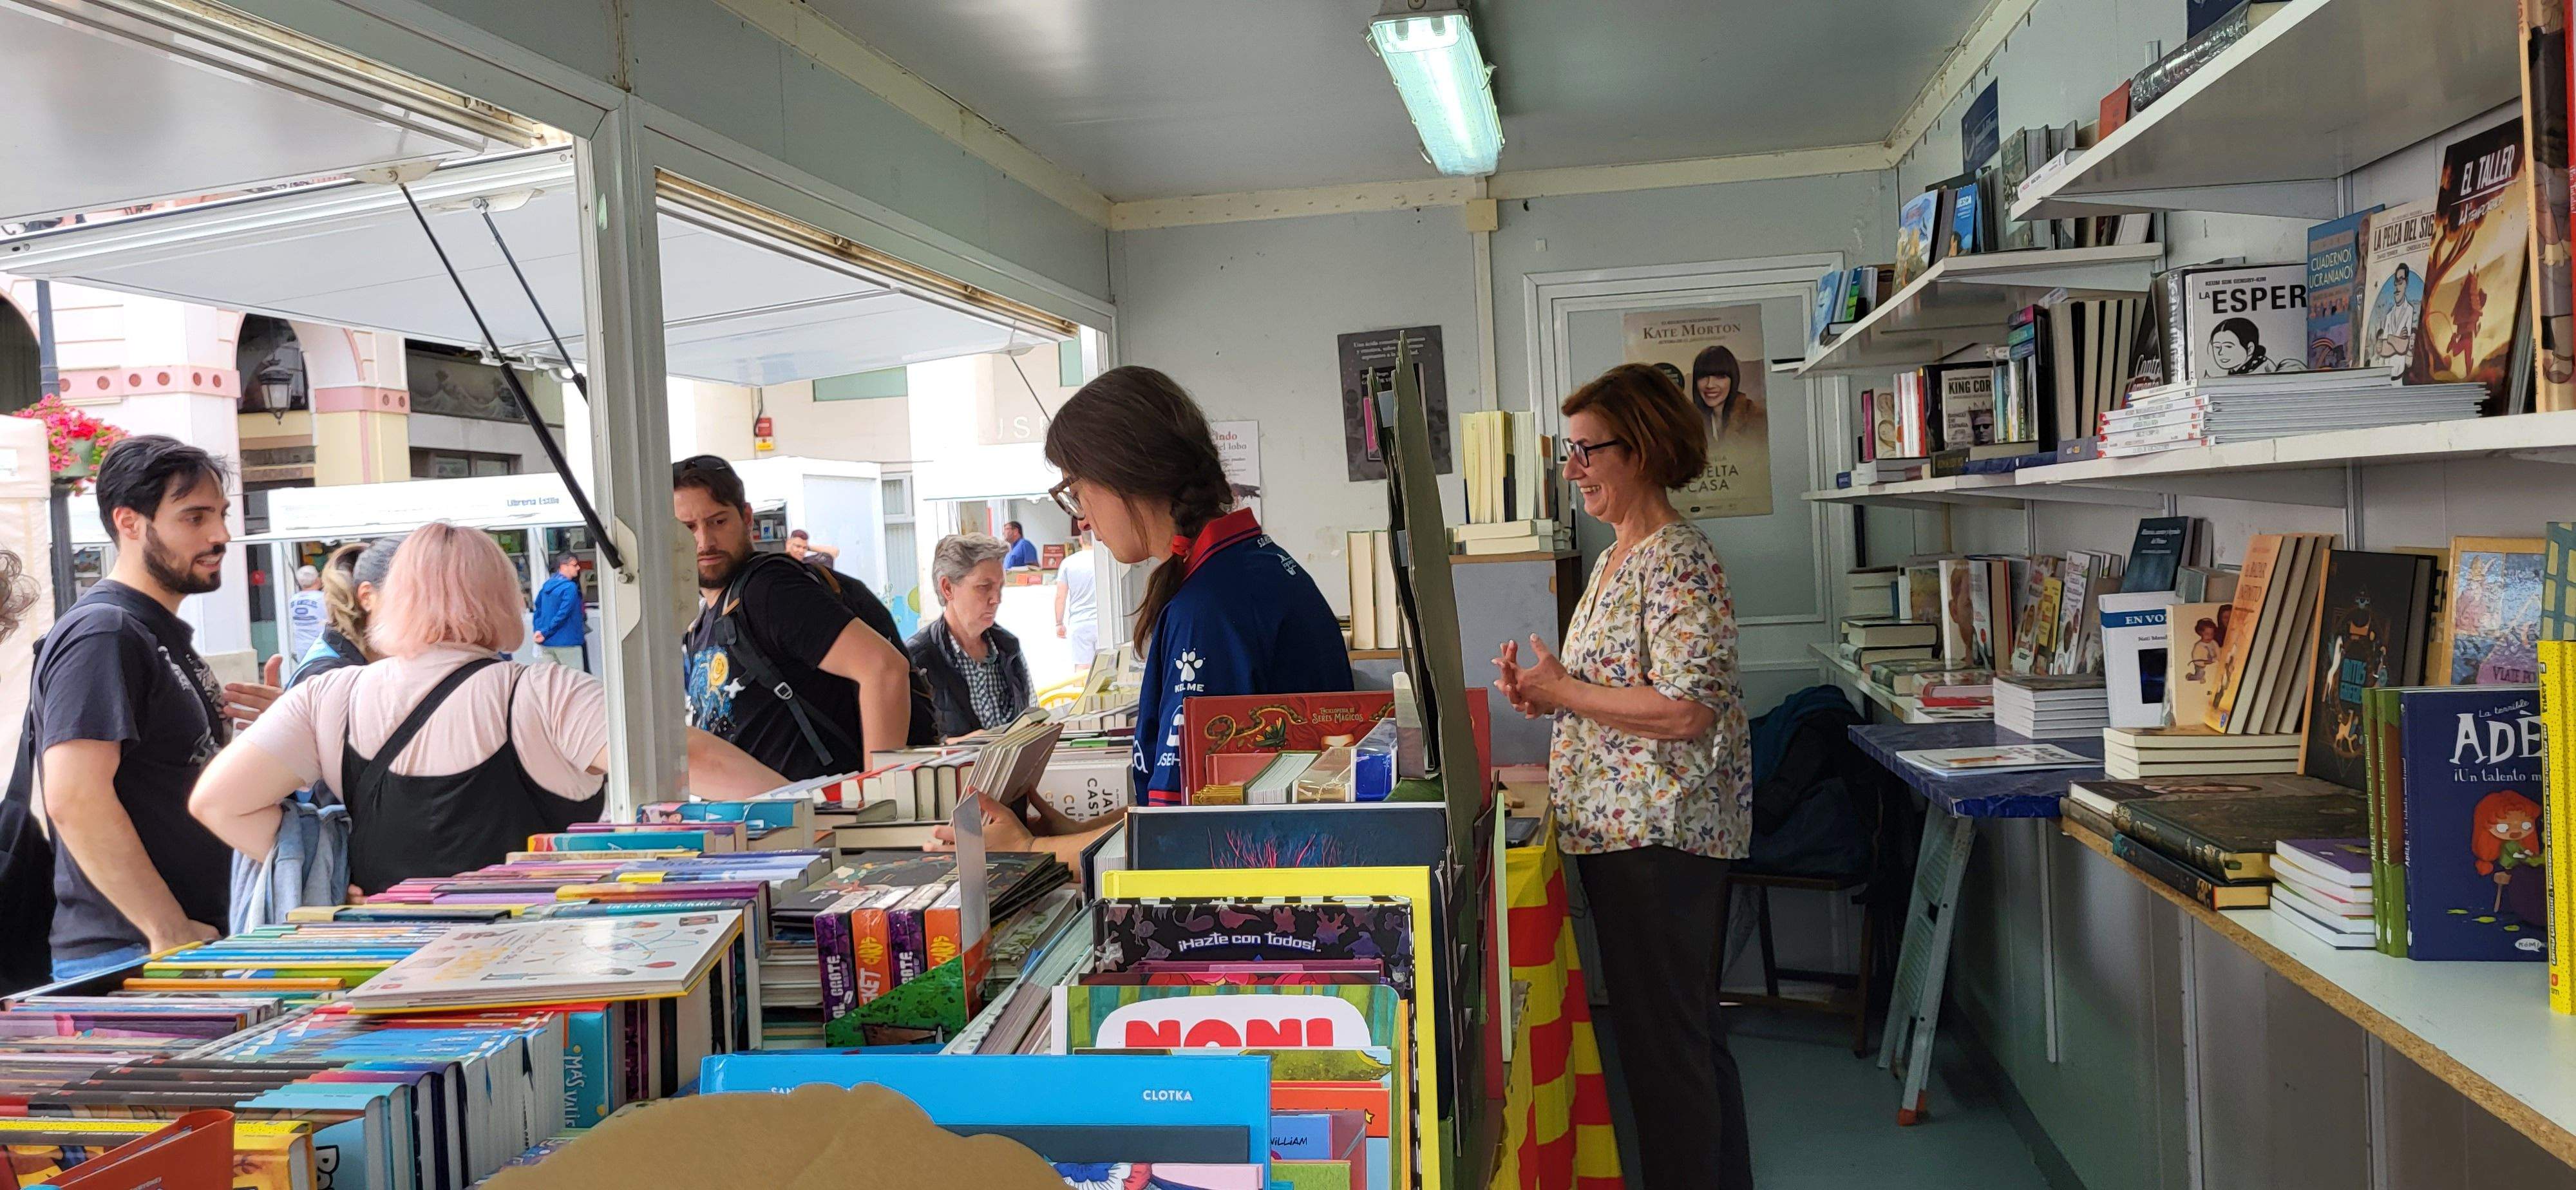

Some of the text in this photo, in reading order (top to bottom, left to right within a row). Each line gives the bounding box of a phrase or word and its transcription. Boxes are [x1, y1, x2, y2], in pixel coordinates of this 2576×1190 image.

[2460, 144, 2515, 196] EL TALLER
[2374, 229, 2382, 251] LA
[2383, 223, 2403, 249] PELEA
[2403, 218, 2417, 242] DEL
[2311, 249, 2352, 272] CUADERNOS
[2309, 265, 2354, 289] UCRANIANOS
[2199, 284, 2307, 314] LA ESPER
[1643, 323, 1741, 339] KATE MORTON
[1948, 381, 1971, 395] KING
[1228, 442, 1247, 450] lobo
[1687, 479, 1730, 493] CASA
[2125, 616, 2143, 625] EN
[1312, 713, 1332, 724] SERES
[2479, 699, 2530, 718] La terrible
[2448, 709, 2543, 765] ADÈ
[2454, 768, 2477, 782] ¡Un
[2481, 768, 2526, 782] talento
[858, 936, 883, 965] CARDS
[1178, 931, 1229, 952] ¡Hazte
[1231, 933, 1262, 945] con
[562, 1053, 589, 1088] MÁS
[1142, 1089, 1193, 1102] CLOTKA
